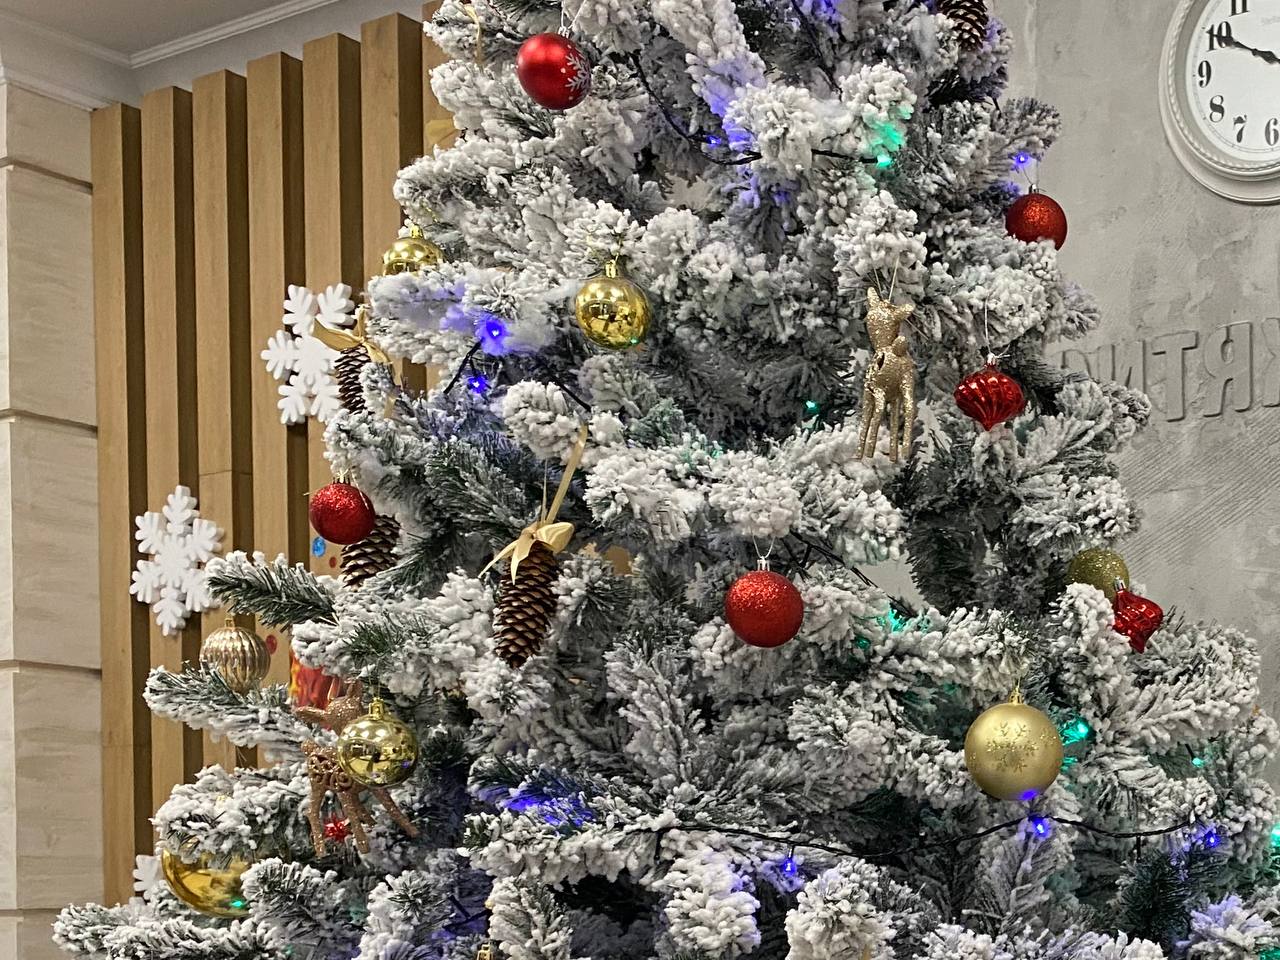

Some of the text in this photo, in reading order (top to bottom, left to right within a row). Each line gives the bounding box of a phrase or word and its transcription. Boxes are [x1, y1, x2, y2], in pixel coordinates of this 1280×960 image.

[1206, 20, 1232, 52] 10
[1197, 60, 1212, 88] 9
[1209, 94, 1225, 123] 8
[1232, 114, 1248, 144] 7
[1264, 117, 1280, 146] 6
